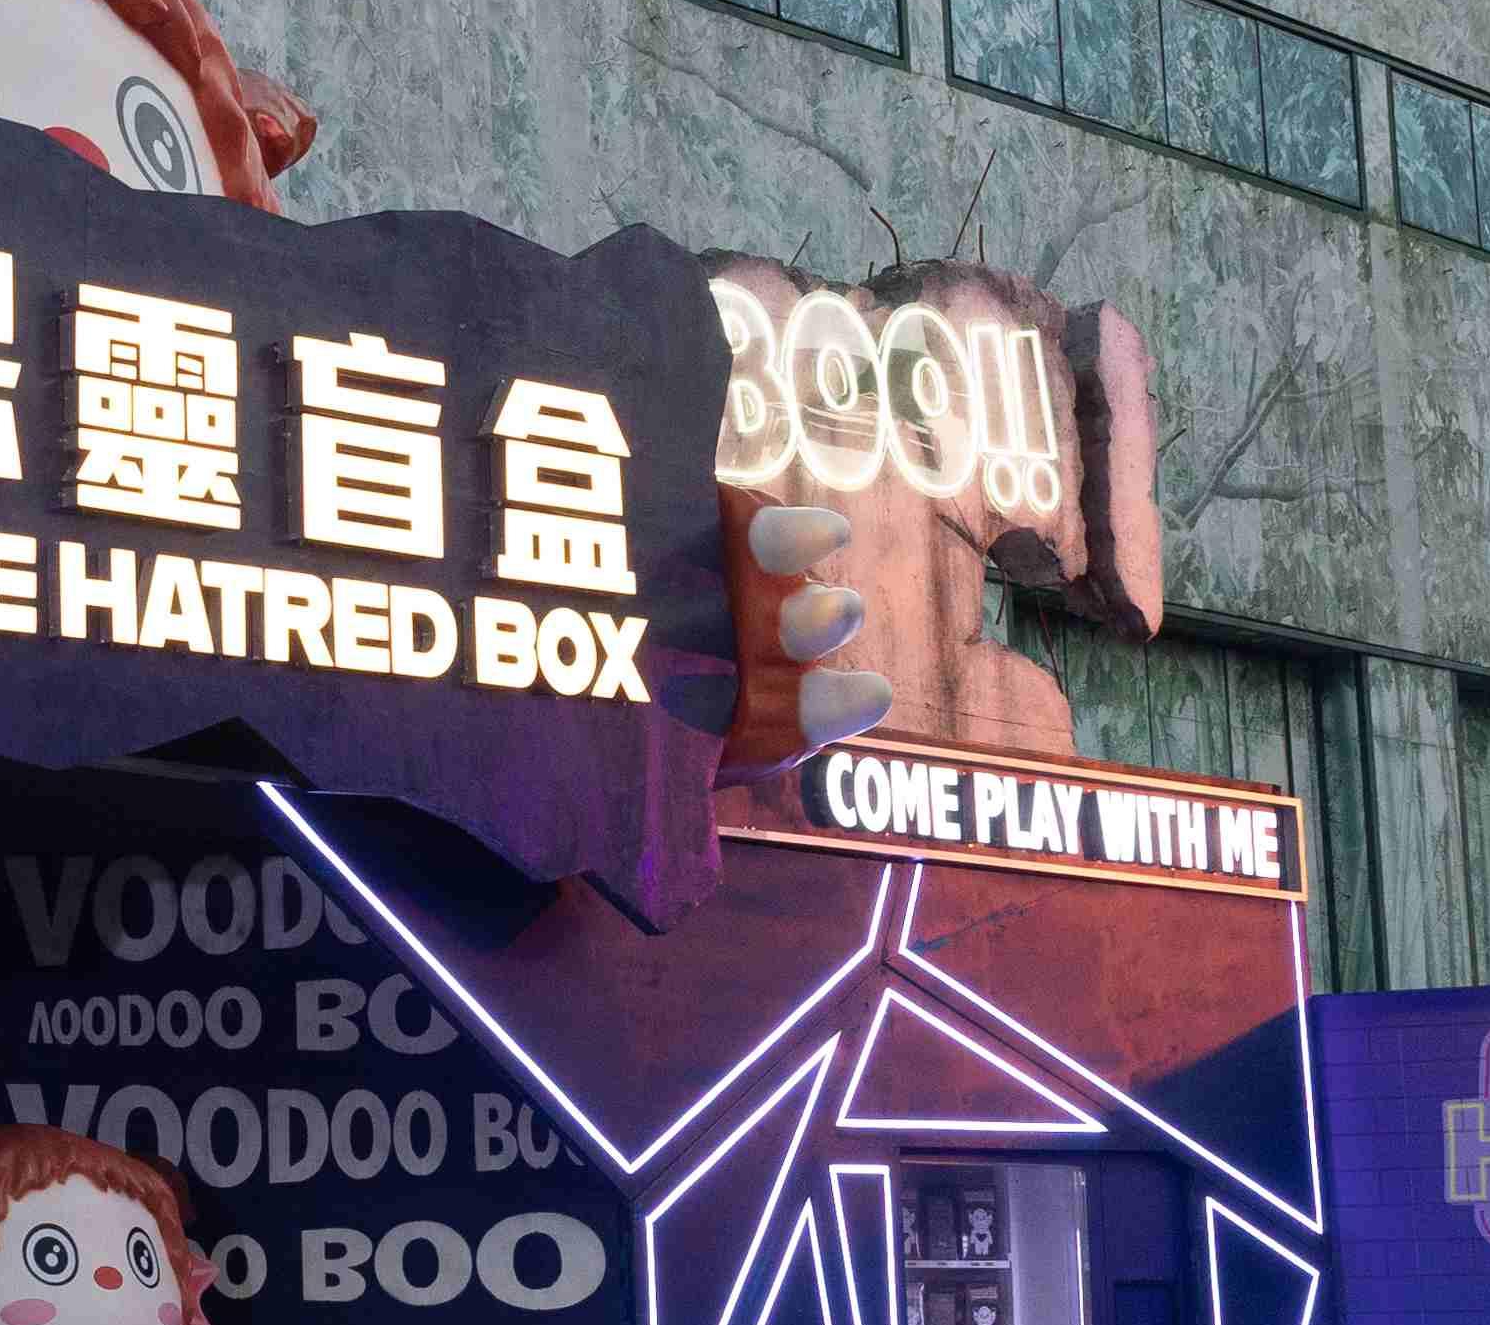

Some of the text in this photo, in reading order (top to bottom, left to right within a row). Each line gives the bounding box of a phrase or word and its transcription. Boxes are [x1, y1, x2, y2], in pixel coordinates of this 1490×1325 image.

[708, 277, 1061, 514] BOO!!
[58, 540, 458, 678] HATRED
[473, 596, 652, 703] BOX
[825, 749, 1281, 879] COME PLAY WITH ME
[4, 854, 367, 966] VOOD
[295, 973, 459, 1055] BO
[473, 1091, 587, 1173] BO
[301, 1211, 607, 1311] BOO
